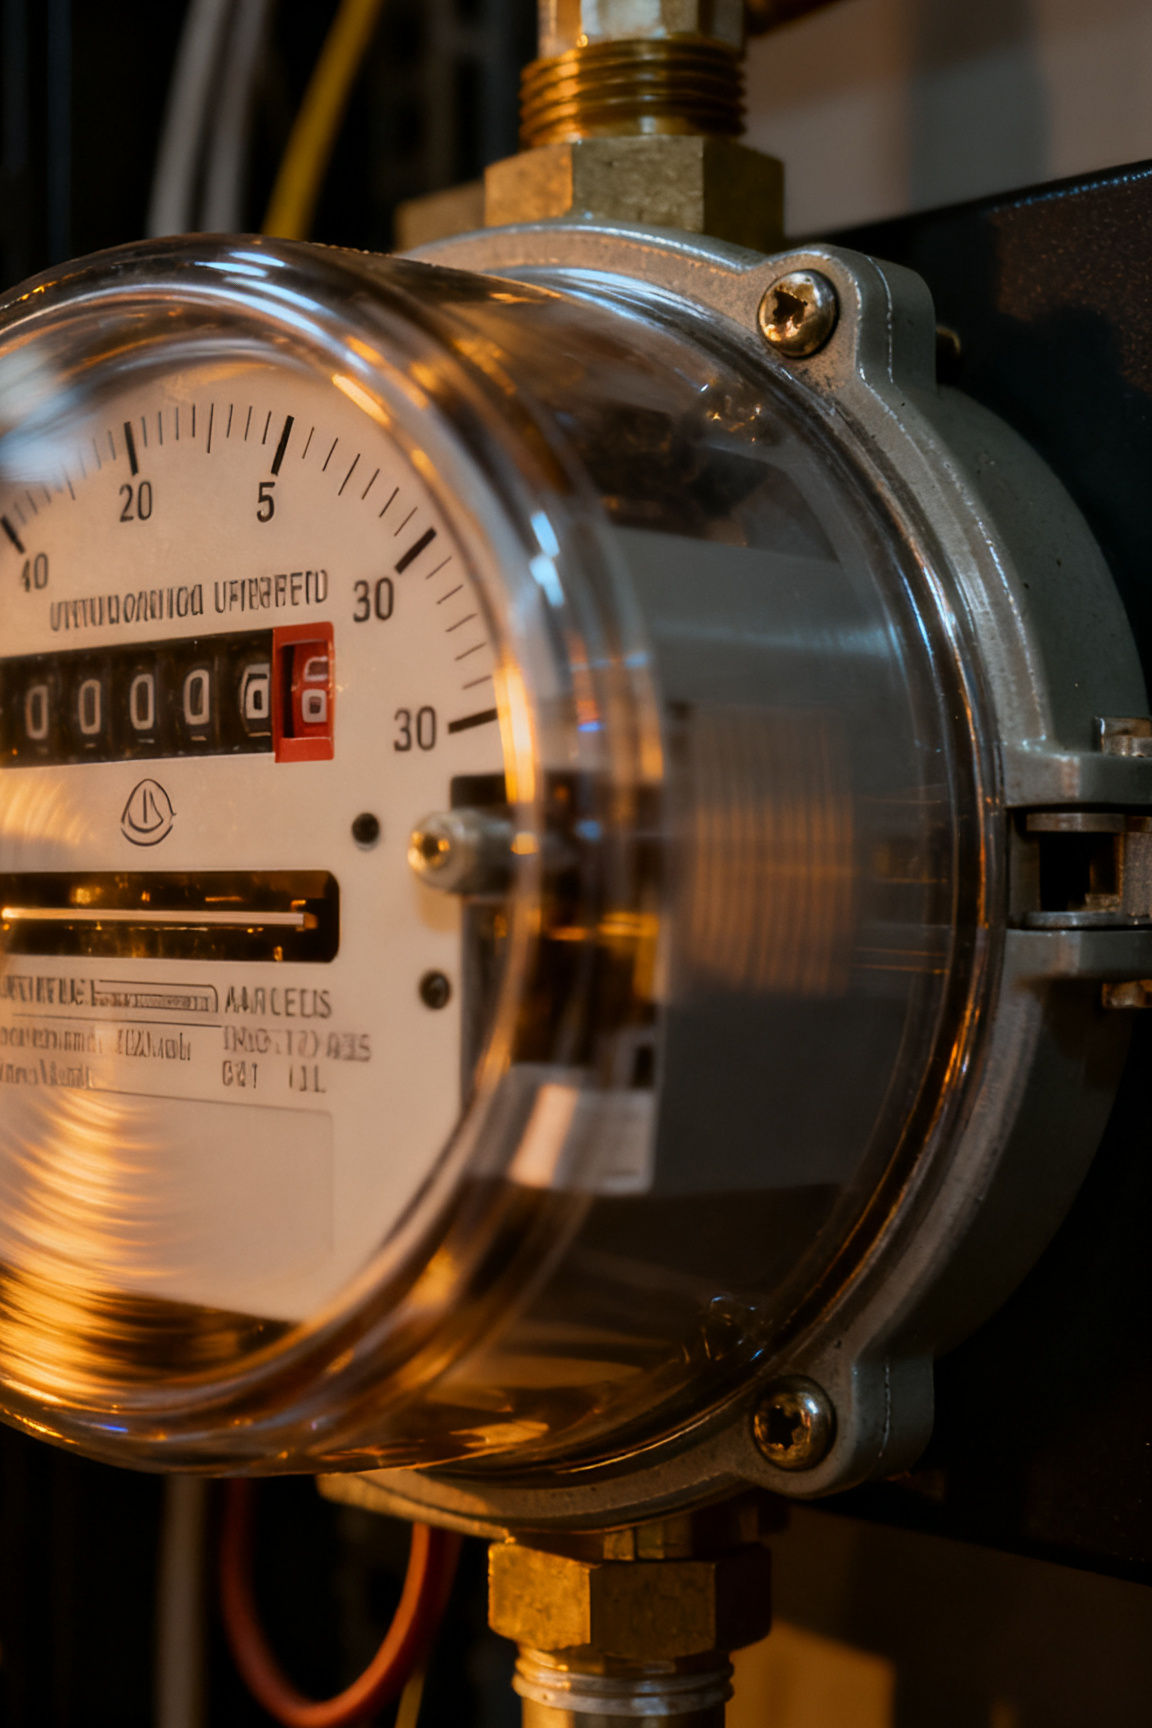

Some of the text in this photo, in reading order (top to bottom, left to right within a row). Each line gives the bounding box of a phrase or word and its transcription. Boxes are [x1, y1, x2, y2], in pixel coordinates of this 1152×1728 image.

[119, 481, 153, 522] 20
[256, 481, 275, 523] 5
[21, 552, 48, 593] 40
[352, 577, 395, 623] 30
[393, 706, 437, 752] 30
